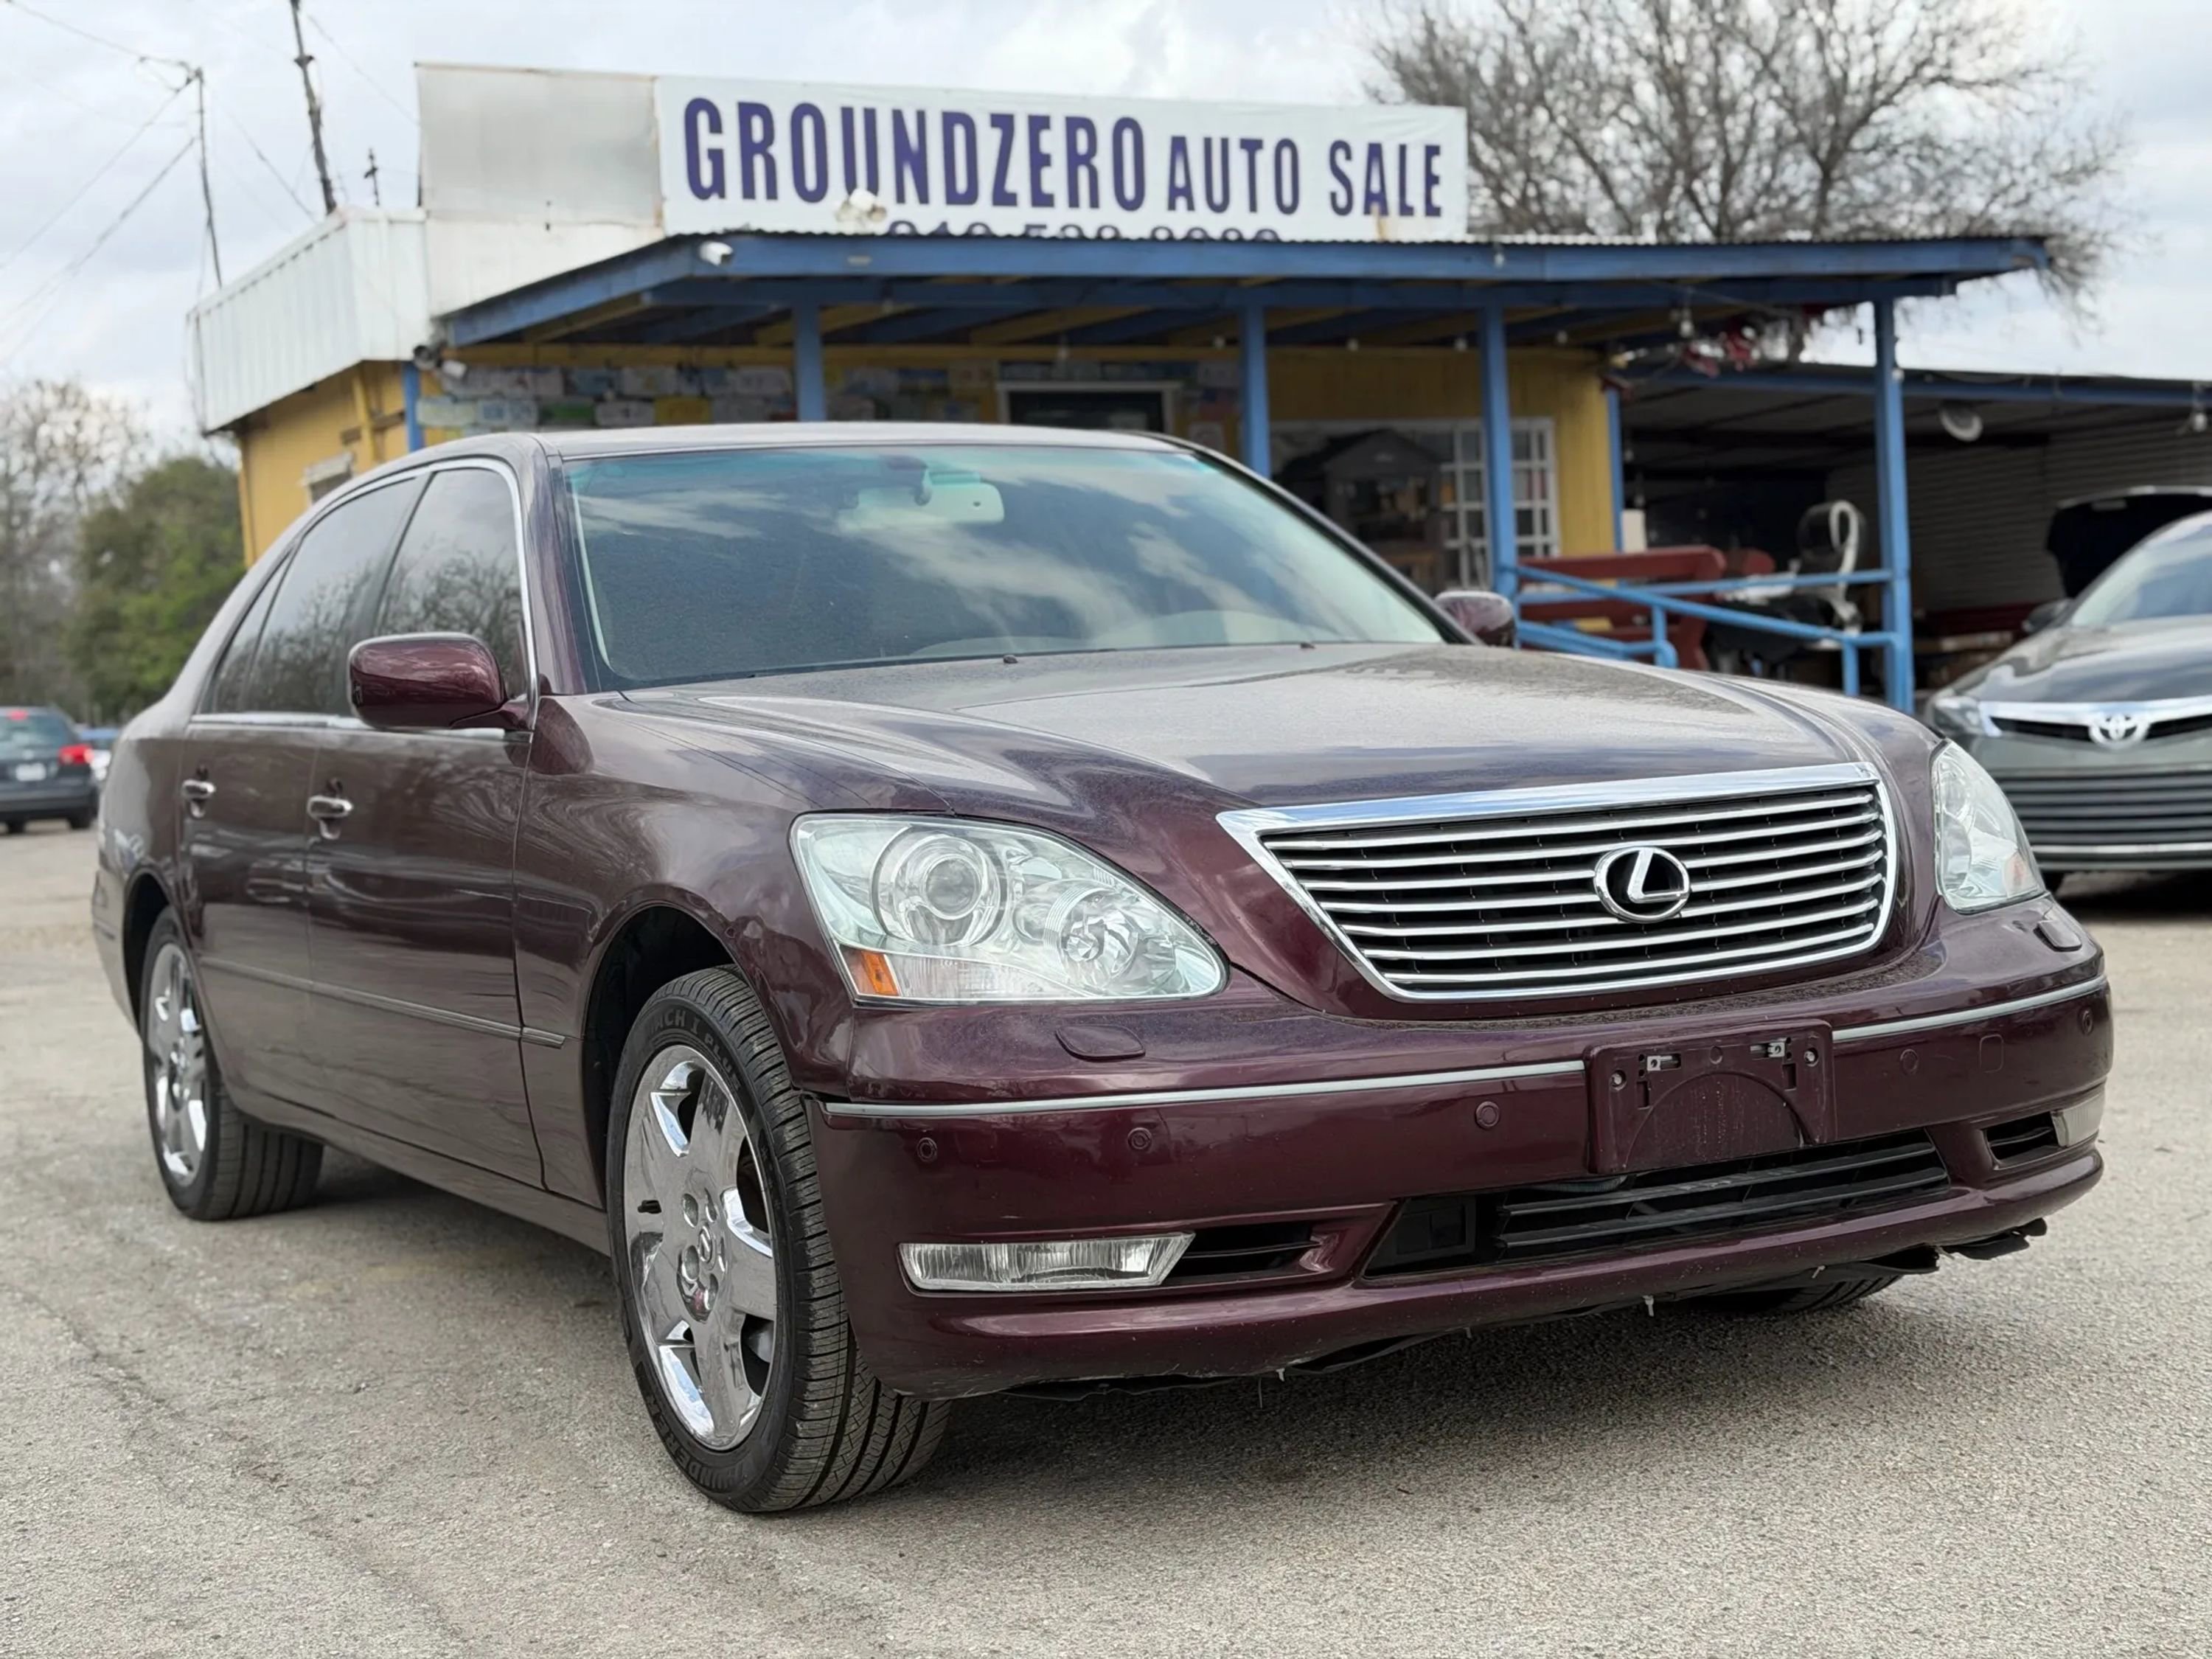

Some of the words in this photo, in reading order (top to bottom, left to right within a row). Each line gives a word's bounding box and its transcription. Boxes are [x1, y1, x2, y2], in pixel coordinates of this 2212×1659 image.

[684, 97, 1146, 212] GROUNDZERO
[1167, 135, 1299, 215] AUTO
[1329, 139, 1441, 217] SALE
